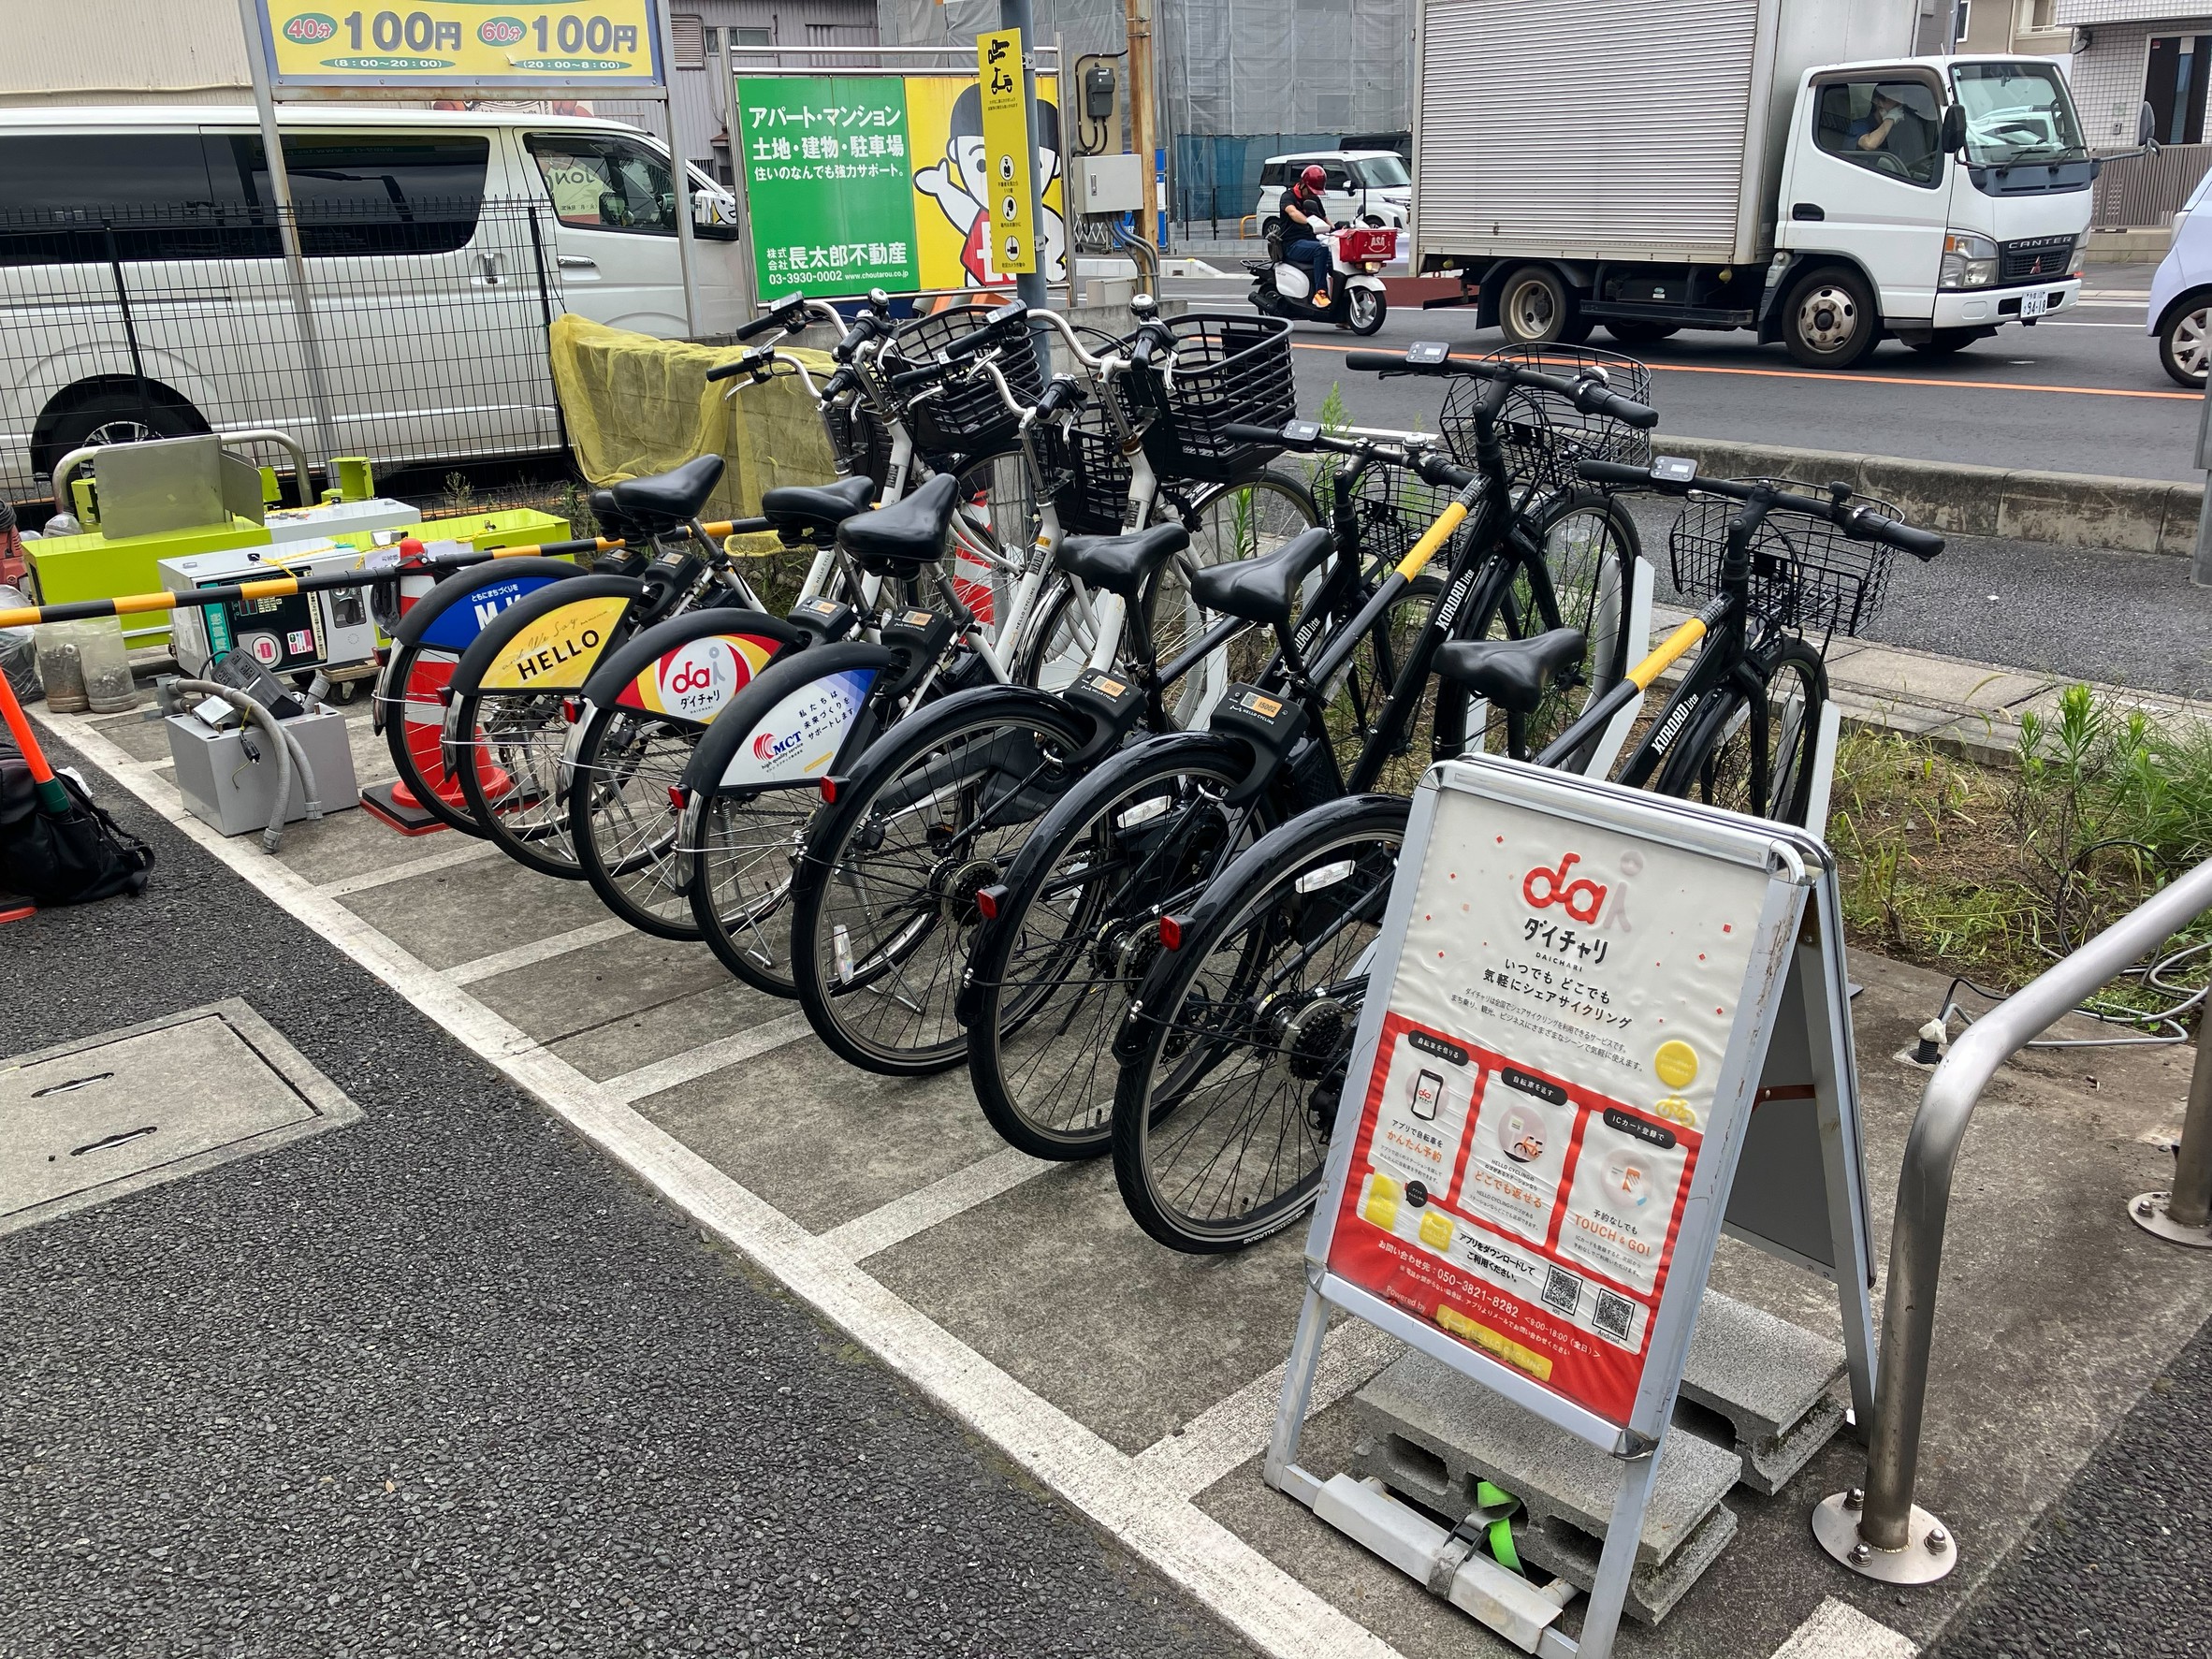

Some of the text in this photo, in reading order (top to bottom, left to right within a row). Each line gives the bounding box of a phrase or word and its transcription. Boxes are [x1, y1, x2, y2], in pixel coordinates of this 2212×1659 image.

[286, 11, 462, 52] 40分 100円
[481, 14, 638, 54] 60分 100円
[749, 105, 902, 129] アパート・マンション
[752, 134, 905, 161] 土地・建物・駐車場
[753, 164, 905, 182] 住いのなんでも強力サポート。
[766, 247, 787, 259] 株式
[1370, 235, 1386, 246] ASA
[2008, 236, 2072, 249] CANTER
[767, 259, 789, 270] 会社
[788, 242, 908, 270] 長太郎不動産
[768, 269, 910, 285] 03-3930-0002 www.choutarou.co.jp
[471, 583, 519, 603] ともにまちづくりを
[517, 629, 600, 681] HELLO
[672, 646, 726, 694] dai
[680, 689, 720, 710] ダイチャリ
[798, 691, 838, 719] 私たちは
[804, 696, 851, 730] 未来づくりを
[808, 707, 854, 740] サポートします
[761, 761, 773, 770] high
[772, 752, 789, 765] quality
[788, 742, 805, 754] service
[772, 730, 802, 756] MCT
[1523, 850, 1644, 933] dai
[1523, 917, 1608, 965] ダイチャリ
[1535, 951, 1584, 973] DAICHARI
[1505, 958, 1611, 1005] いつでも どこでも
[1482, 968, 1633, 1030] 気軽にシェアサイクリング
[1450, 993, 1644, 1073] まち乗り、観光、ビジネスにさまざまなシーンで気軽に使えます。
[1465, 987, 1627, 1055] ダイチャリは全国でシェアサイクリングを利用できるサービスです。
[1418, 1037, 1460, 1059] 自転車を借りる
[1512, 1075, 1555, 1097] 自転車を返す
[1391, 1119, 1444, 1149] アプリで自転車を
[1612, 1114, 1666, 1142] ICカード登録で
[1386, 1130, 1443, 1164] かんたん予約
[1492, 1159, 1507, 1170] HELLO
[1475, 1170, 1542, 1209] どこでも返せる
[1593, 1208, 1638, 1235] 予約なしでも
[1575, 1214, 1652, 1258] TOUCH & GO!
[1459, 1232, 1536, 1276] アプリをダウンロードして
[1466, 1251, 1518, 1284] ご利用ください。
[1386, 1285, 1427, 1312] Powered by
[1437, 1268, 1520, 1318] 050-3821-8282
[1469, 1328, 1502, 1351] HELLO
[1597, 1329, 1622, 1346] Android
